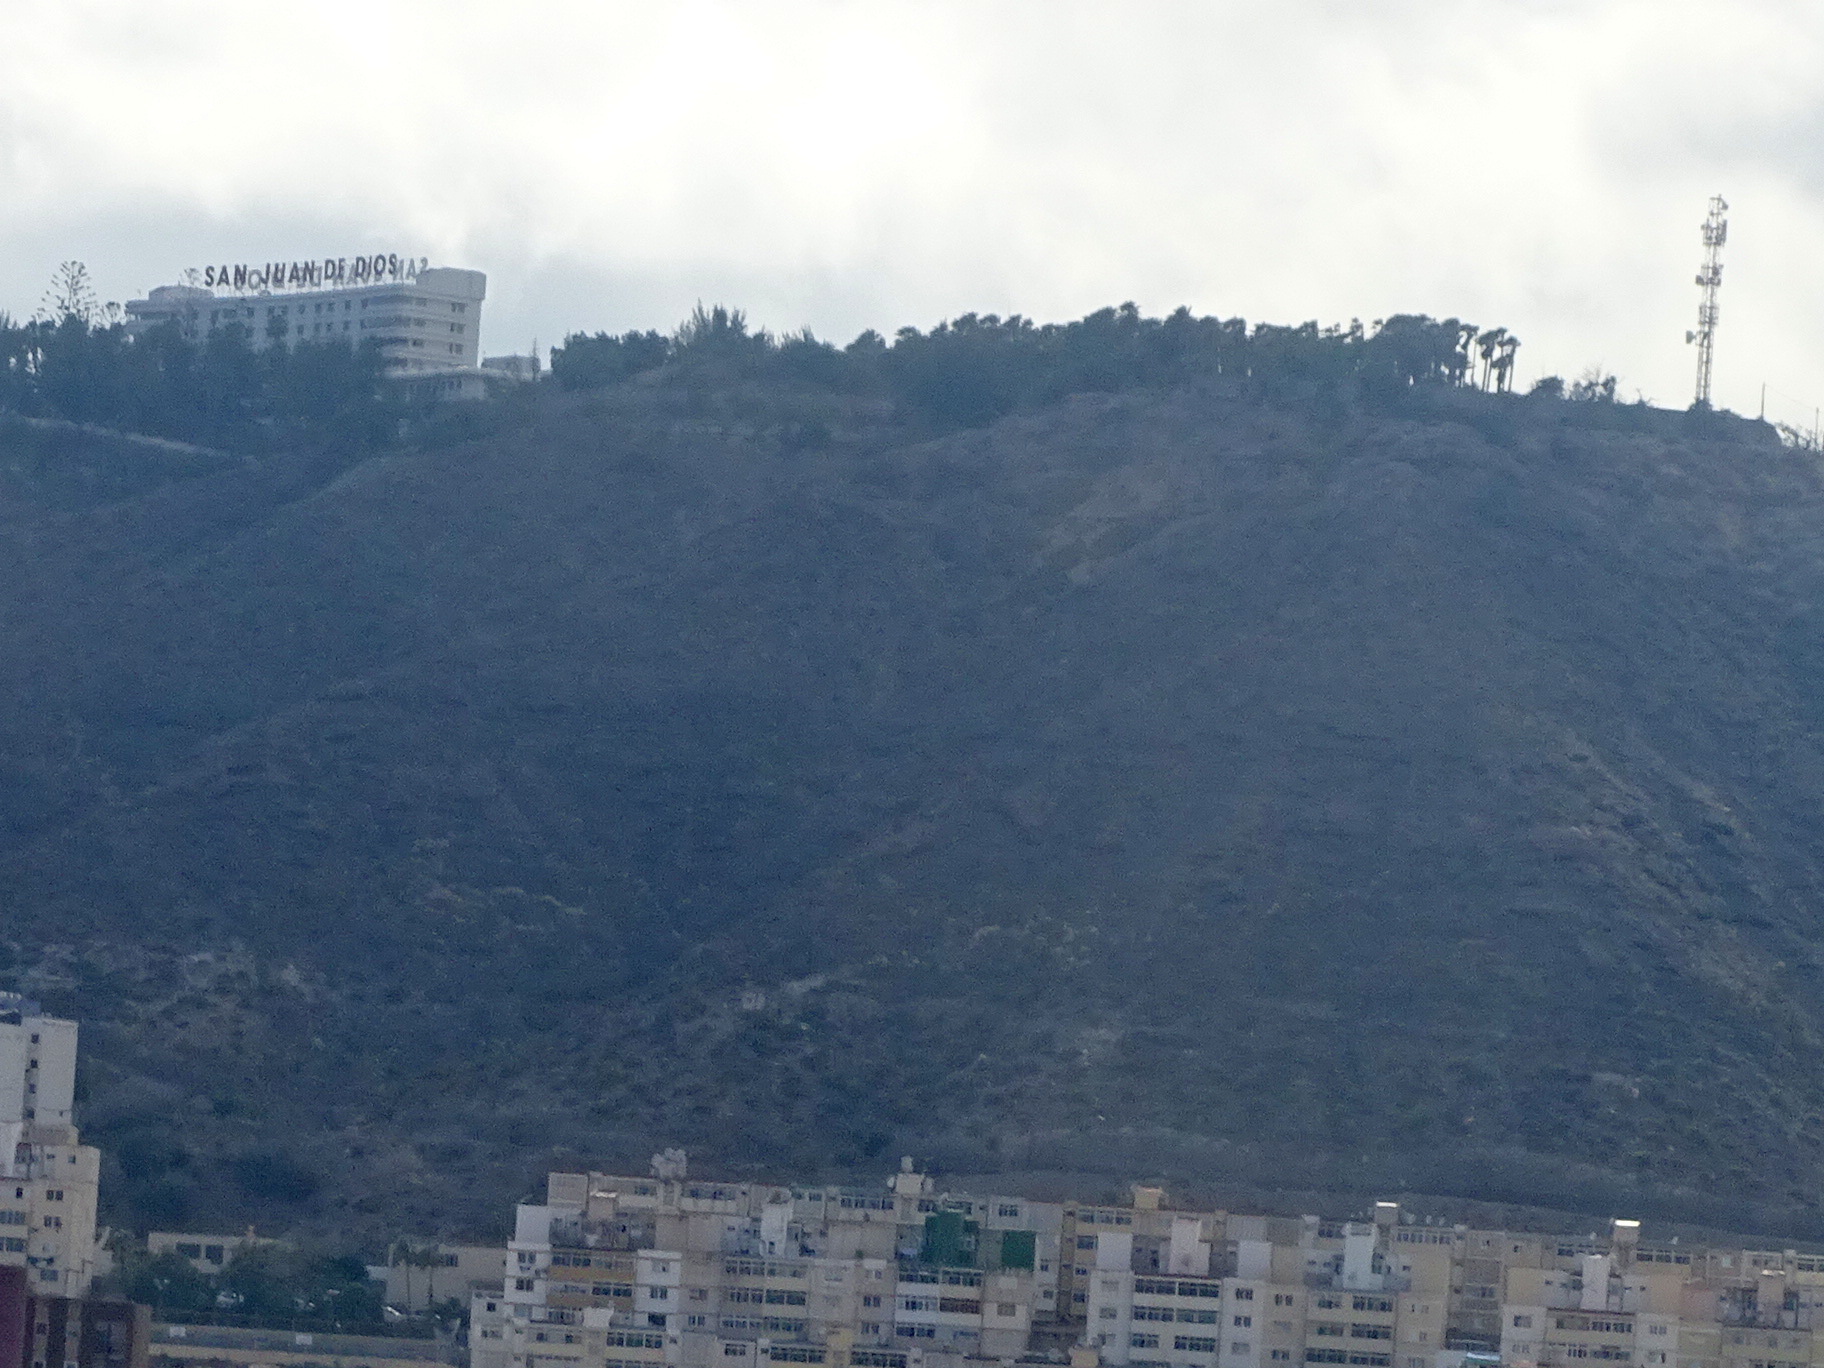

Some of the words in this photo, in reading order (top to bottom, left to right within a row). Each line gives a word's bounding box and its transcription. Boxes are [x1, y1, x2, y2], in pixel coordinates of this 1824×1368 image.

[204, 263, 247, 287] SAN
[260, 259, 316, 285] JUAN
[323, 257, 345, 280] DE
[355, 253, 397, 279] DIOS
